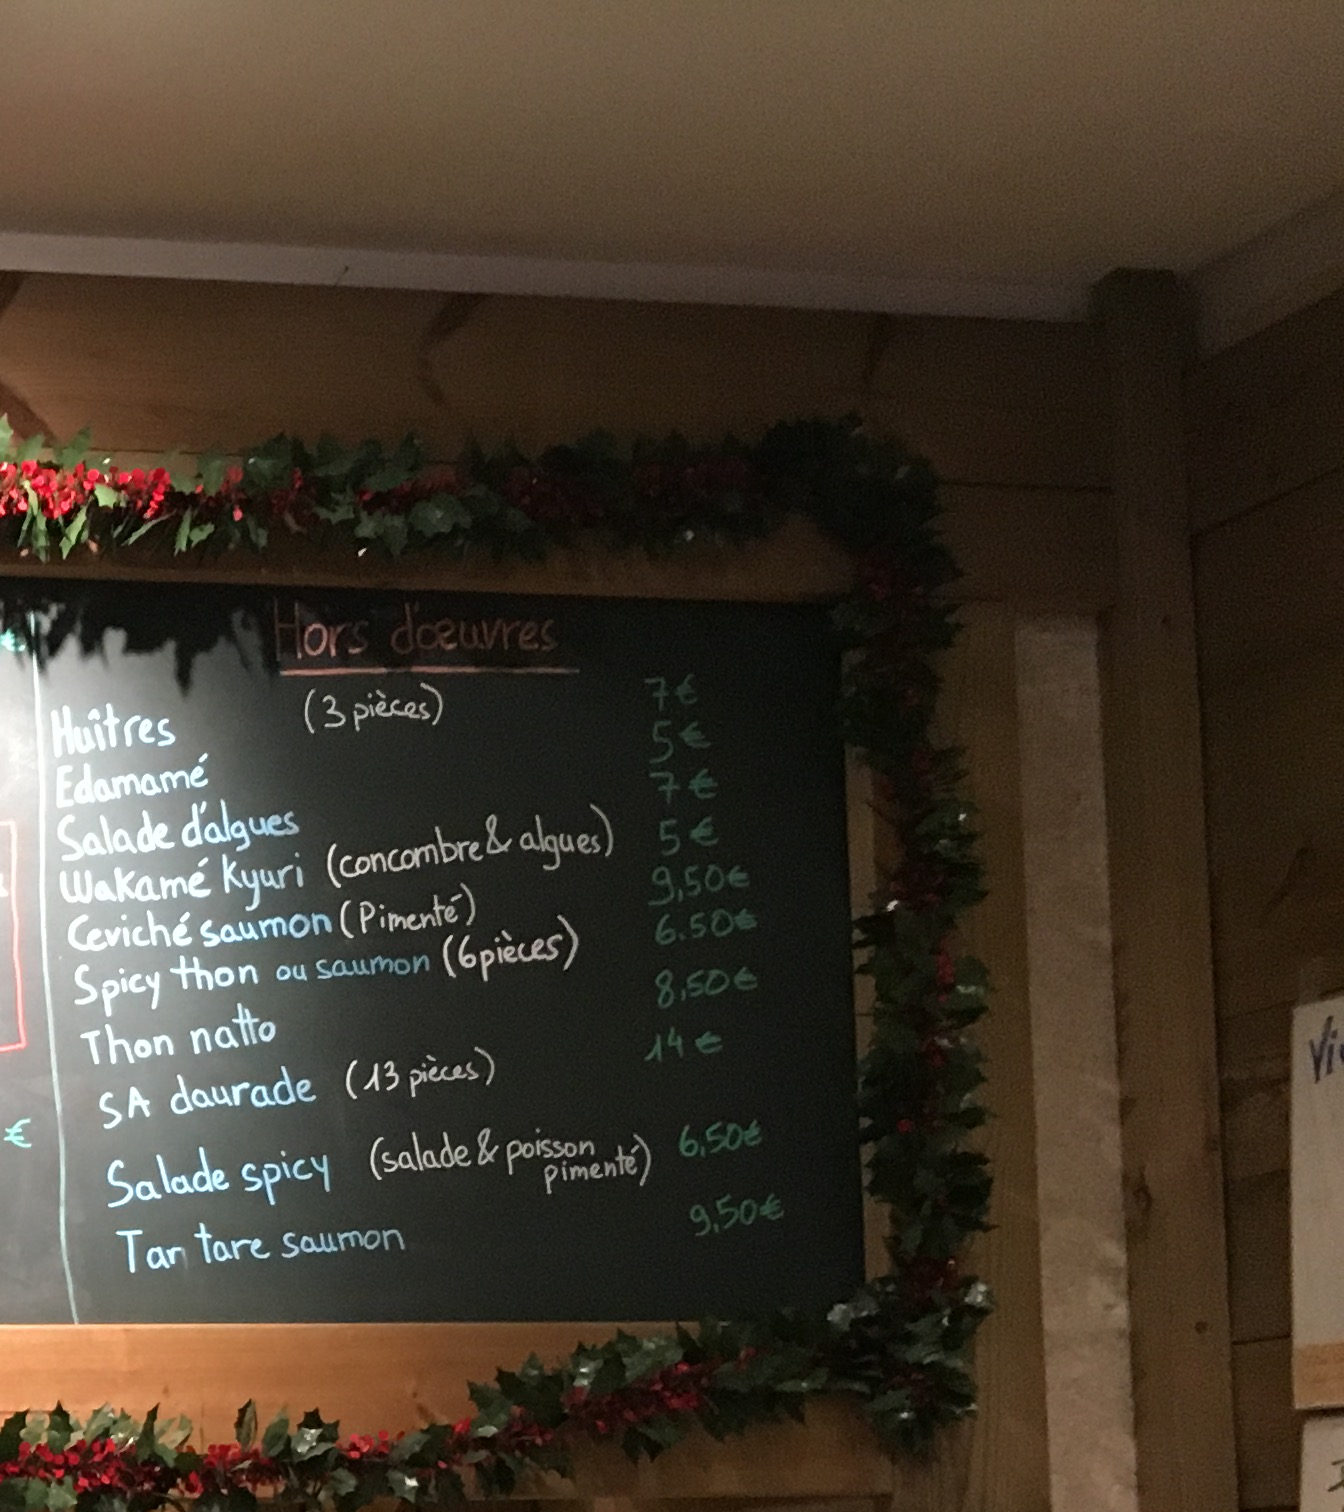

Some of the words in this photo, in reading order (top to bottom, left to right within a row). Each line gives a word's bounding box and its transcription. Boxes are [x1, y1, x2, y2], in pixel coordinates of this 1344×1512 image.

[274, 597, 369, 660] Hors
[51, 704, 176, 758] Huîtres
[56, 754, 209, 807] Edamamé
[57, 810, 175, 861] Salade
[327, 825, 483, 888] (concombre
[519, 804, 612, 870] algues)
[67, 910, 193, 952] Ceviché
[200, 912, 332, 946] saumon
[74, 964, 161, 1016] Spicy
[169, 956, 259, 991] thon
[276, 963, 308, 982] ou
[316, 952, 430, 979] saumon
[80, 1023, 174, 1066] Thon
[191, 1004, 277, 1055] natto
[99, 1087, 150, 1130] SA
[170, 1065, 317, 1115] daurade
[107, 1147, 229, 1208] Salade
[241, 1150, 331, 1206] spicy
[370, 1131, 471, 1180] (salade
[506, 1128, 595, 1175] poisson
[282, 1228, 405, 1259] saumon
